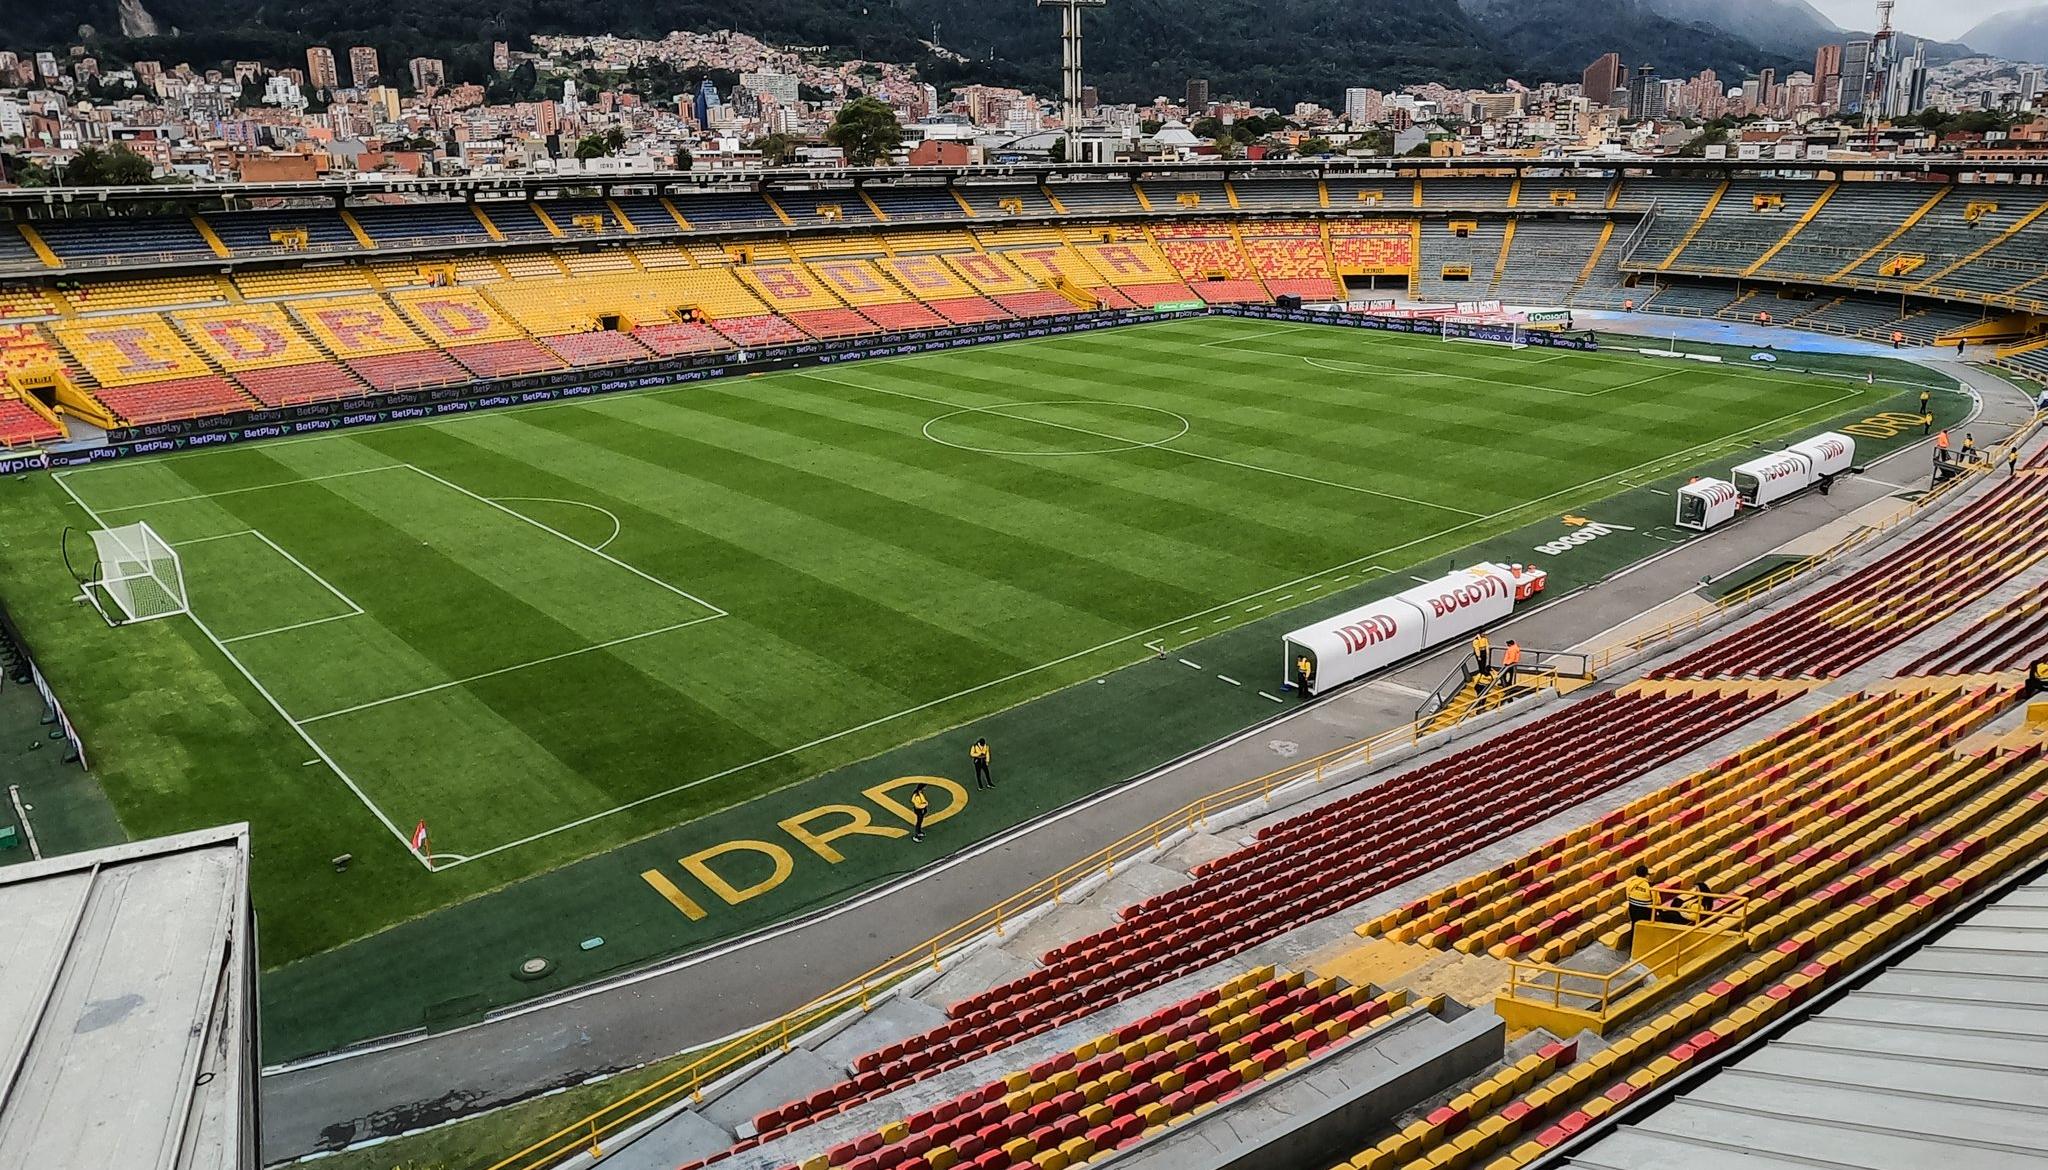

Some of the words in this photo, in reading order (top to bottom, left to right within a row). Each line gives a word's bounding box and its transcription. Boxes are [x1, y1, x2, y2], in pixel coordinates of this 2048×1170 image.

[135, 440, 174, 453] BetPlay
[190, 433, 227, 445] BetPlay
[244, 426, 280, 438] BetPlay
[296, 419, 330, 431] BetPlay
[344, 413, 377, 425] BetPlay
[392, 407, 424, 418] BetPlay
[437, 402, 468, 412] BetPlay
[480, 397, 509, 407] BetPlay
[522, 391, 550, 401] BetPlay
[563, 386, 590, 396] BetPlay
[602, 381, 628, 390] BetPlay
[639, 376, 665, 386] BetPlay
[676, 371, 701, 381] BetPlay
[1332, 613, 1398, 656] IDRD
[640, 776, 970, 922] IDRD
